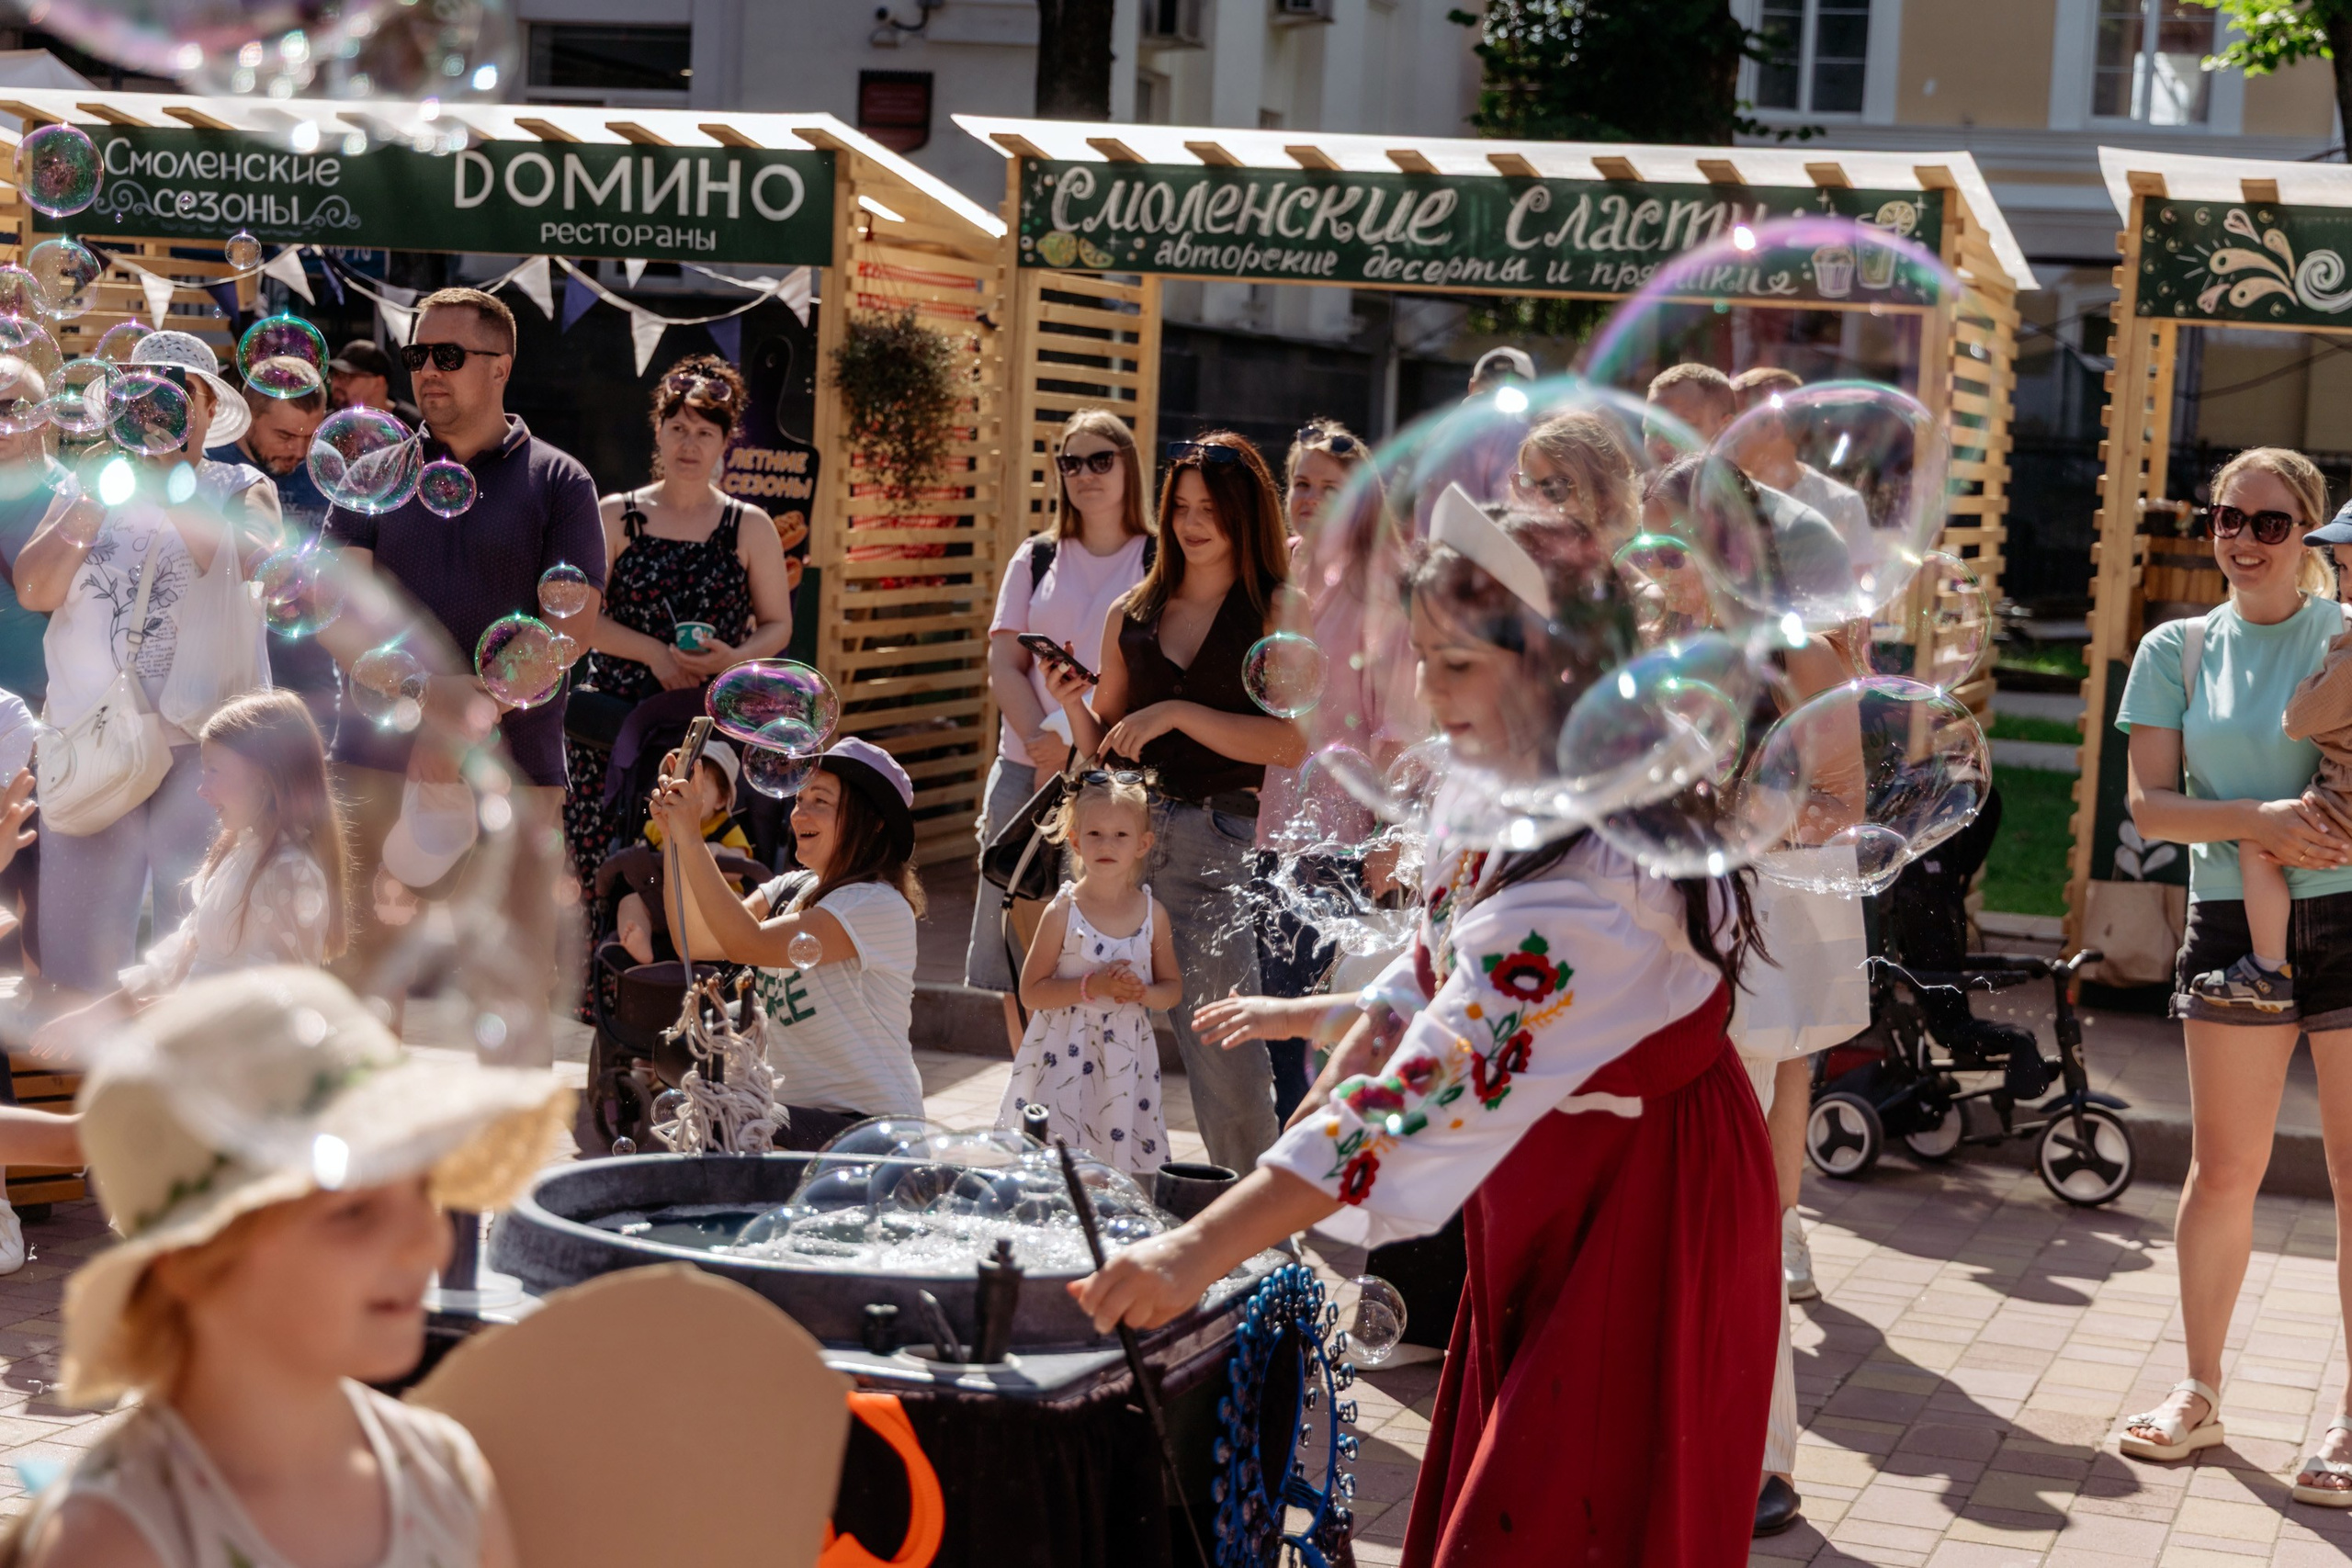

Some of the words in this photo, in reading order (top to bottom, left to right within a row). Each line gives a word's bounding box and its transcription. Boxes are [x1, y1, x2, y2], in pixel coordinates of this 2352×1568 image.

[105, 137, 341, 187] Смоленские
[153, 187, 300, 226] сезоны
[1050, 165, 1459, 247] Смоленские
[540, 221, 717, 252] рестораны
[1154, 229, 1340, 276] авторские
[1363, 244, 1535, 286] десерты
[1544, 258, 1573, 286] и
[1589, 261, 1799, 296] пряики
[728, 447, 809, 474] ЛЕТНИЕ
[724, 472, 813, 500] СЕЗОНЫ
